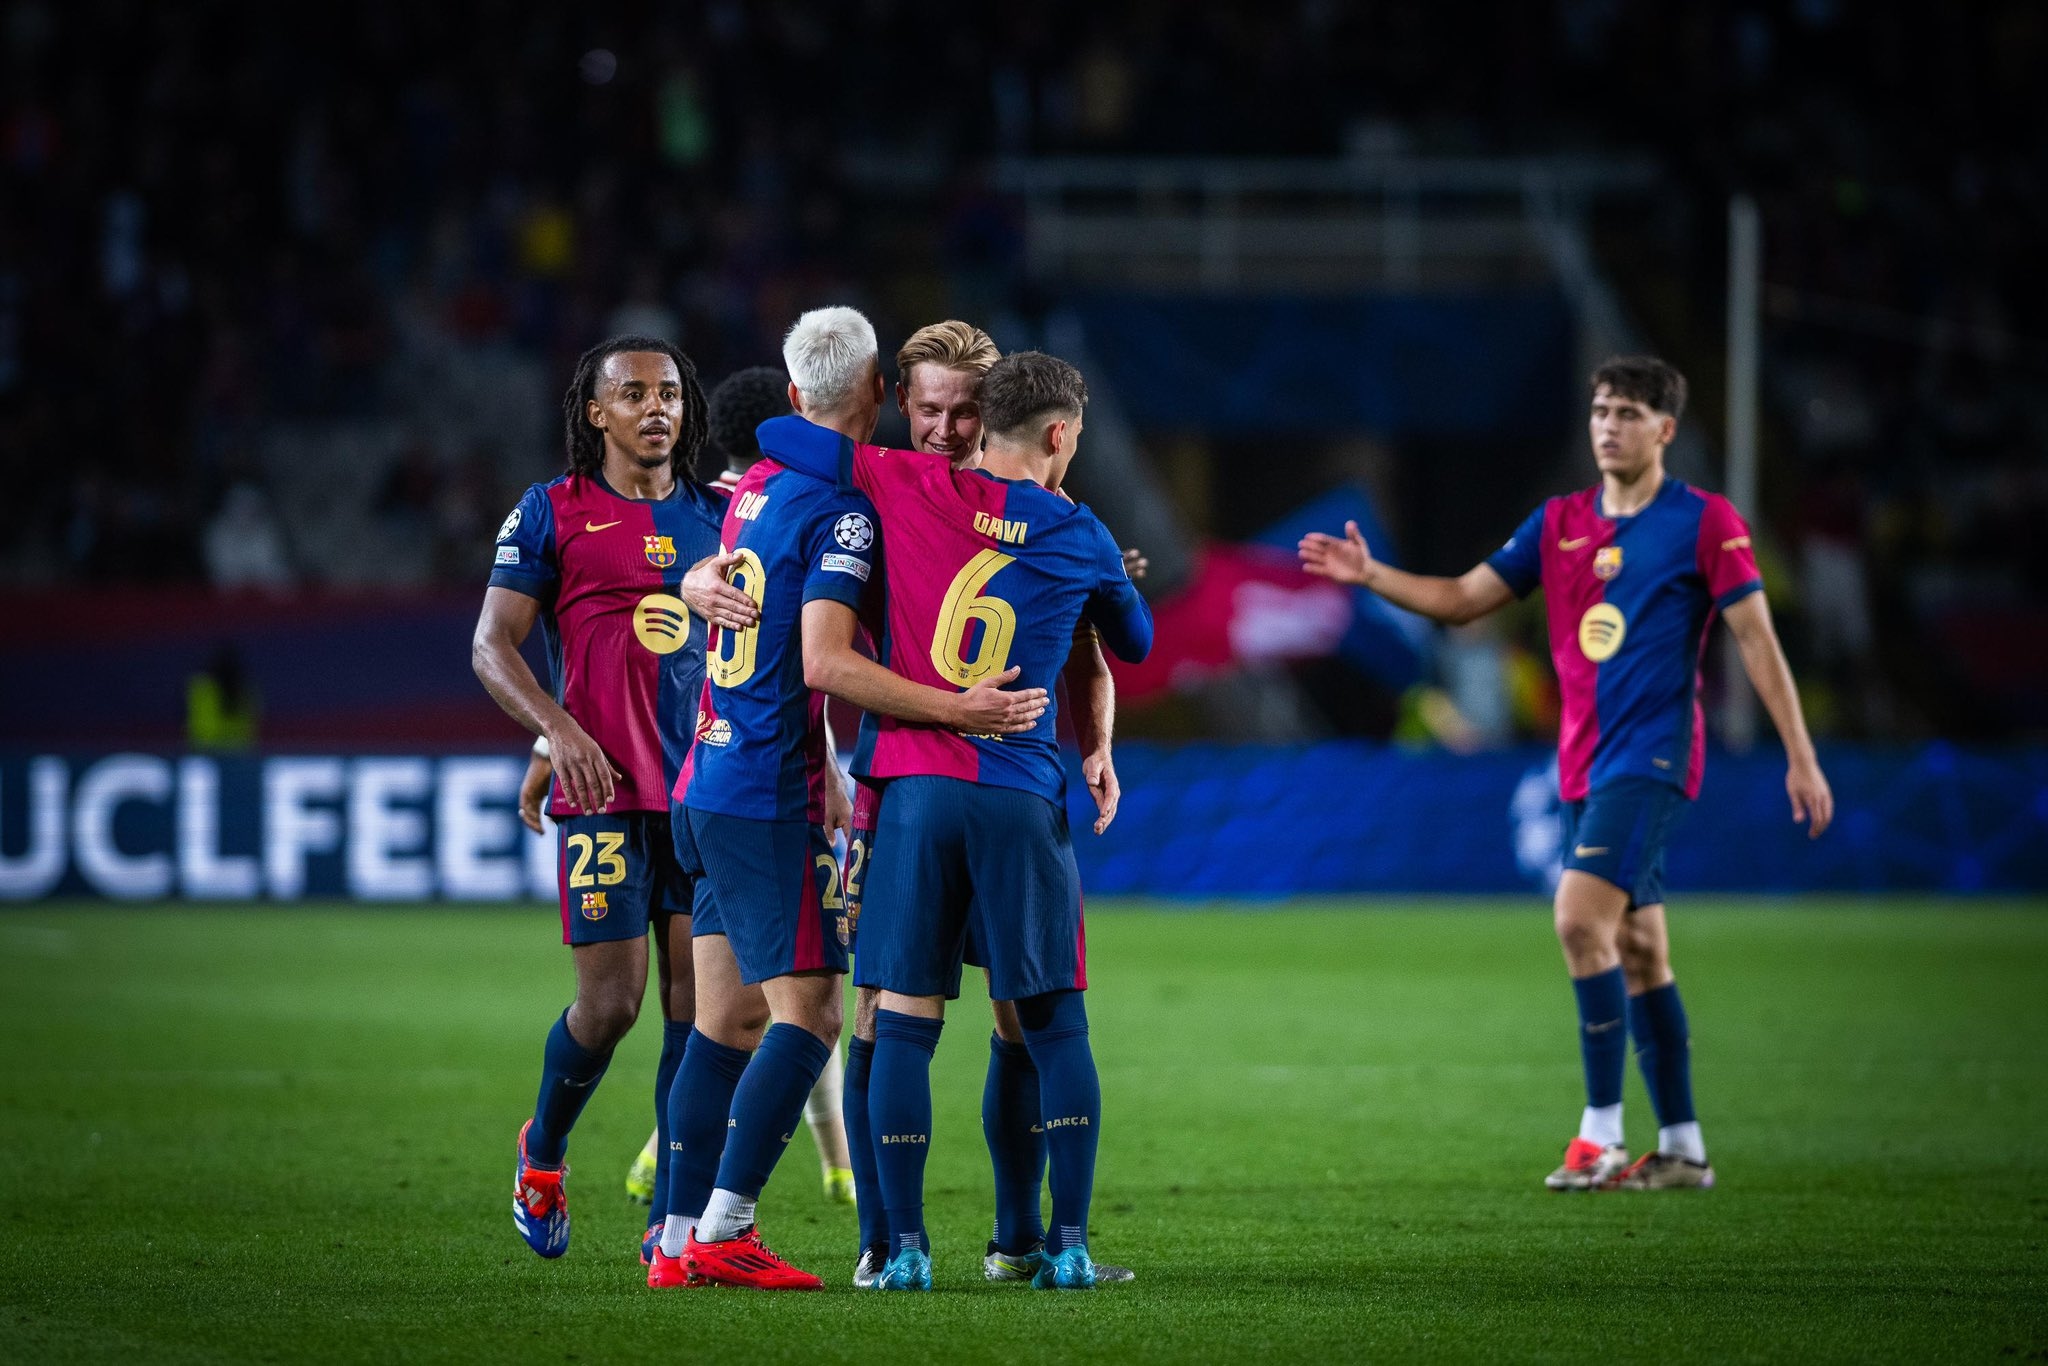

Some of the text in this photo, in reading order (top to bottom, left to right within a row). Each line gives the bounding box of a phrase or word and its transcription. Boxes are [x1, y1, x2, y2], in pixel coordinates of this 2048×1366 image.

[850, 524, 860, 539] 5
[973, 511, 1028, 544] GAVI
[930, 548, 1017, 689] 6
[567, 831, 627, 889] 23
[846, 838, 874, 896] 2
